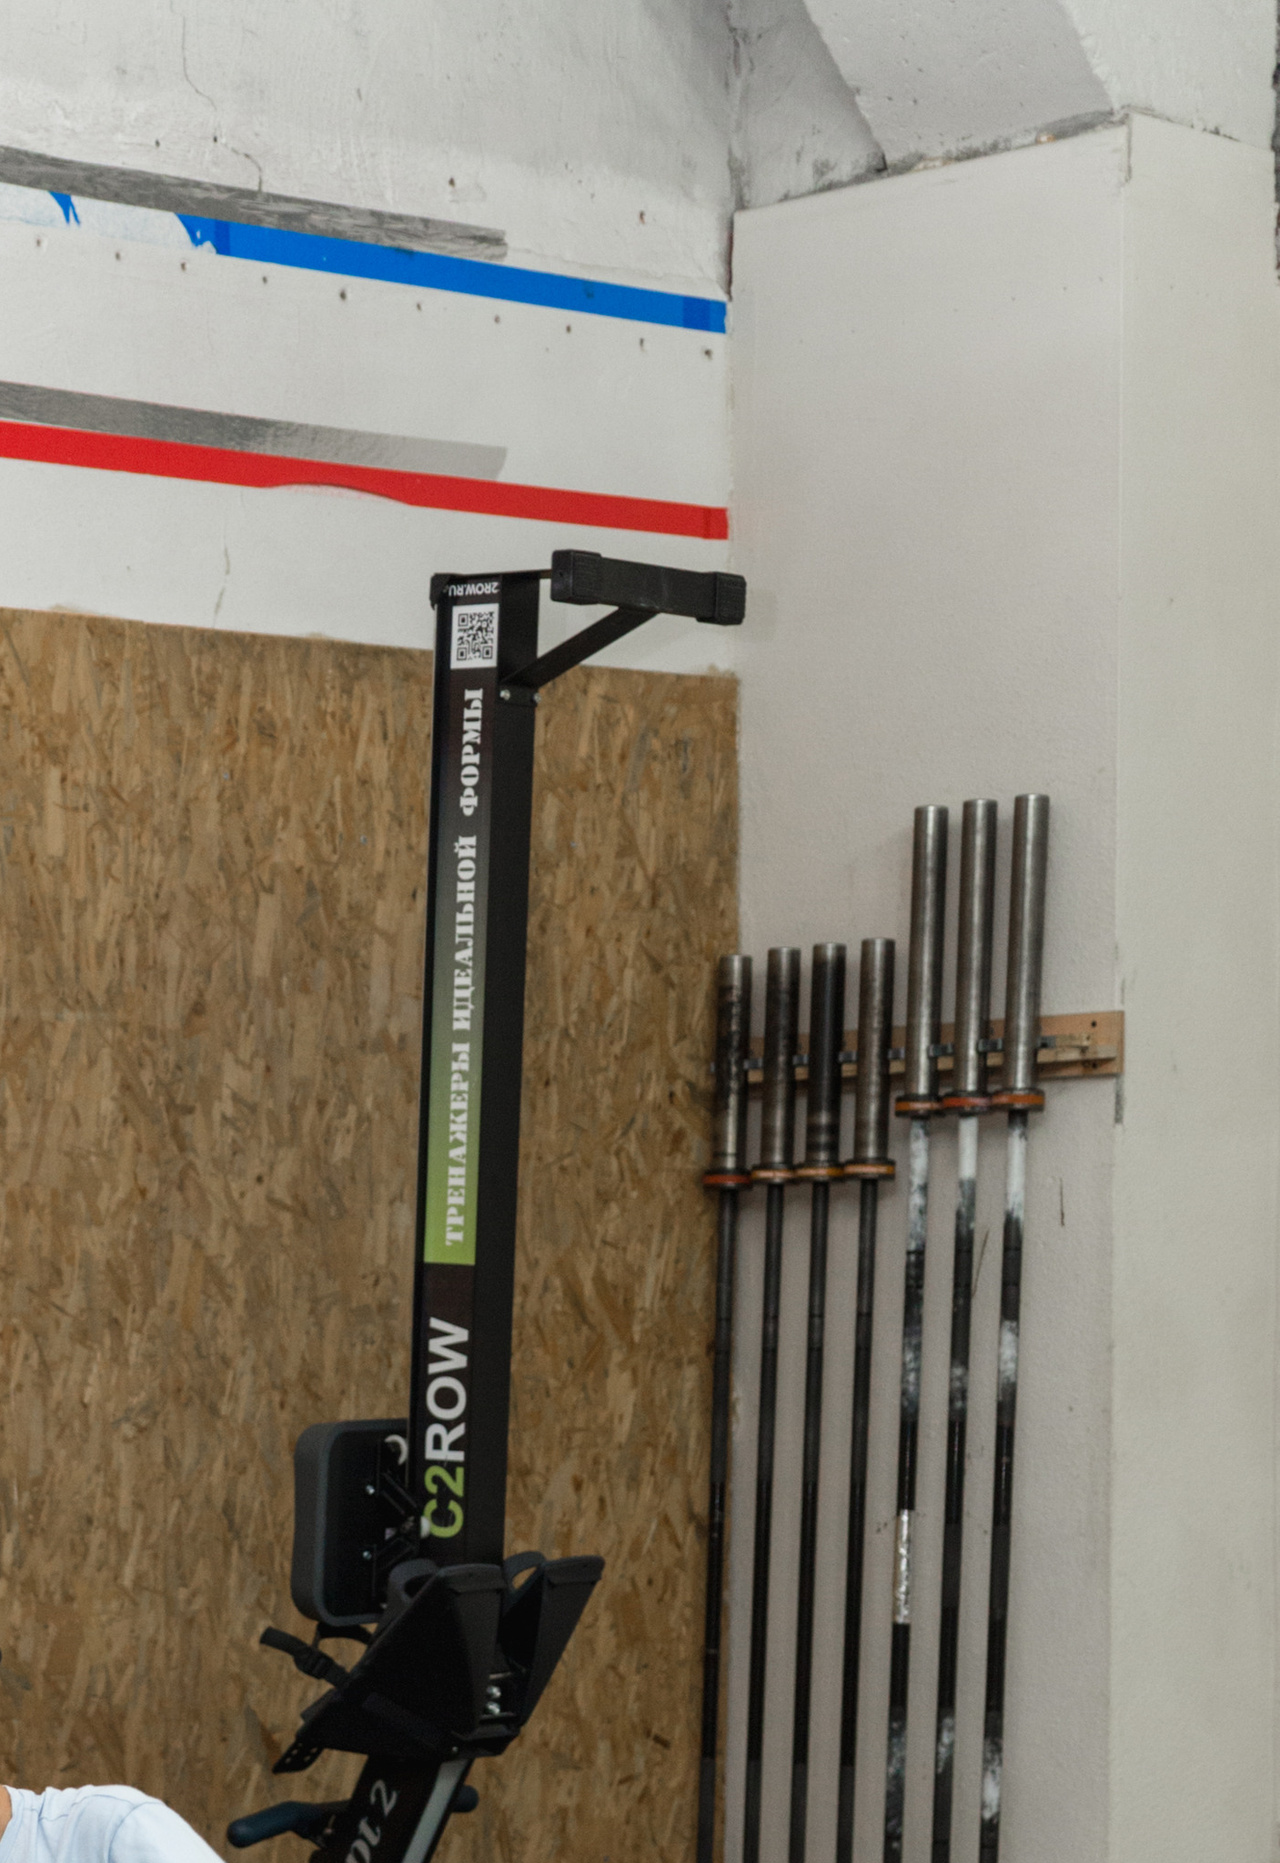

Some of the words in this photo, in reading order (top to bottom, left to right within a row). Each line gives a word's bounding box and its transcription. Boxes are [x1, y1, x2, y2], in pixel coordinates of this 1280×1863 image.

[460, 688, 483, 817] ФОРМЫ
[452, 835, 477, 1031] ИДЕАЛЬНОЙ
[445, 1042, 470, 1246] ТРЕНАЖЕРЫ
[423, 1316, 469, 1538] C2ROW
[369, 1780, 399, 1816] 2
